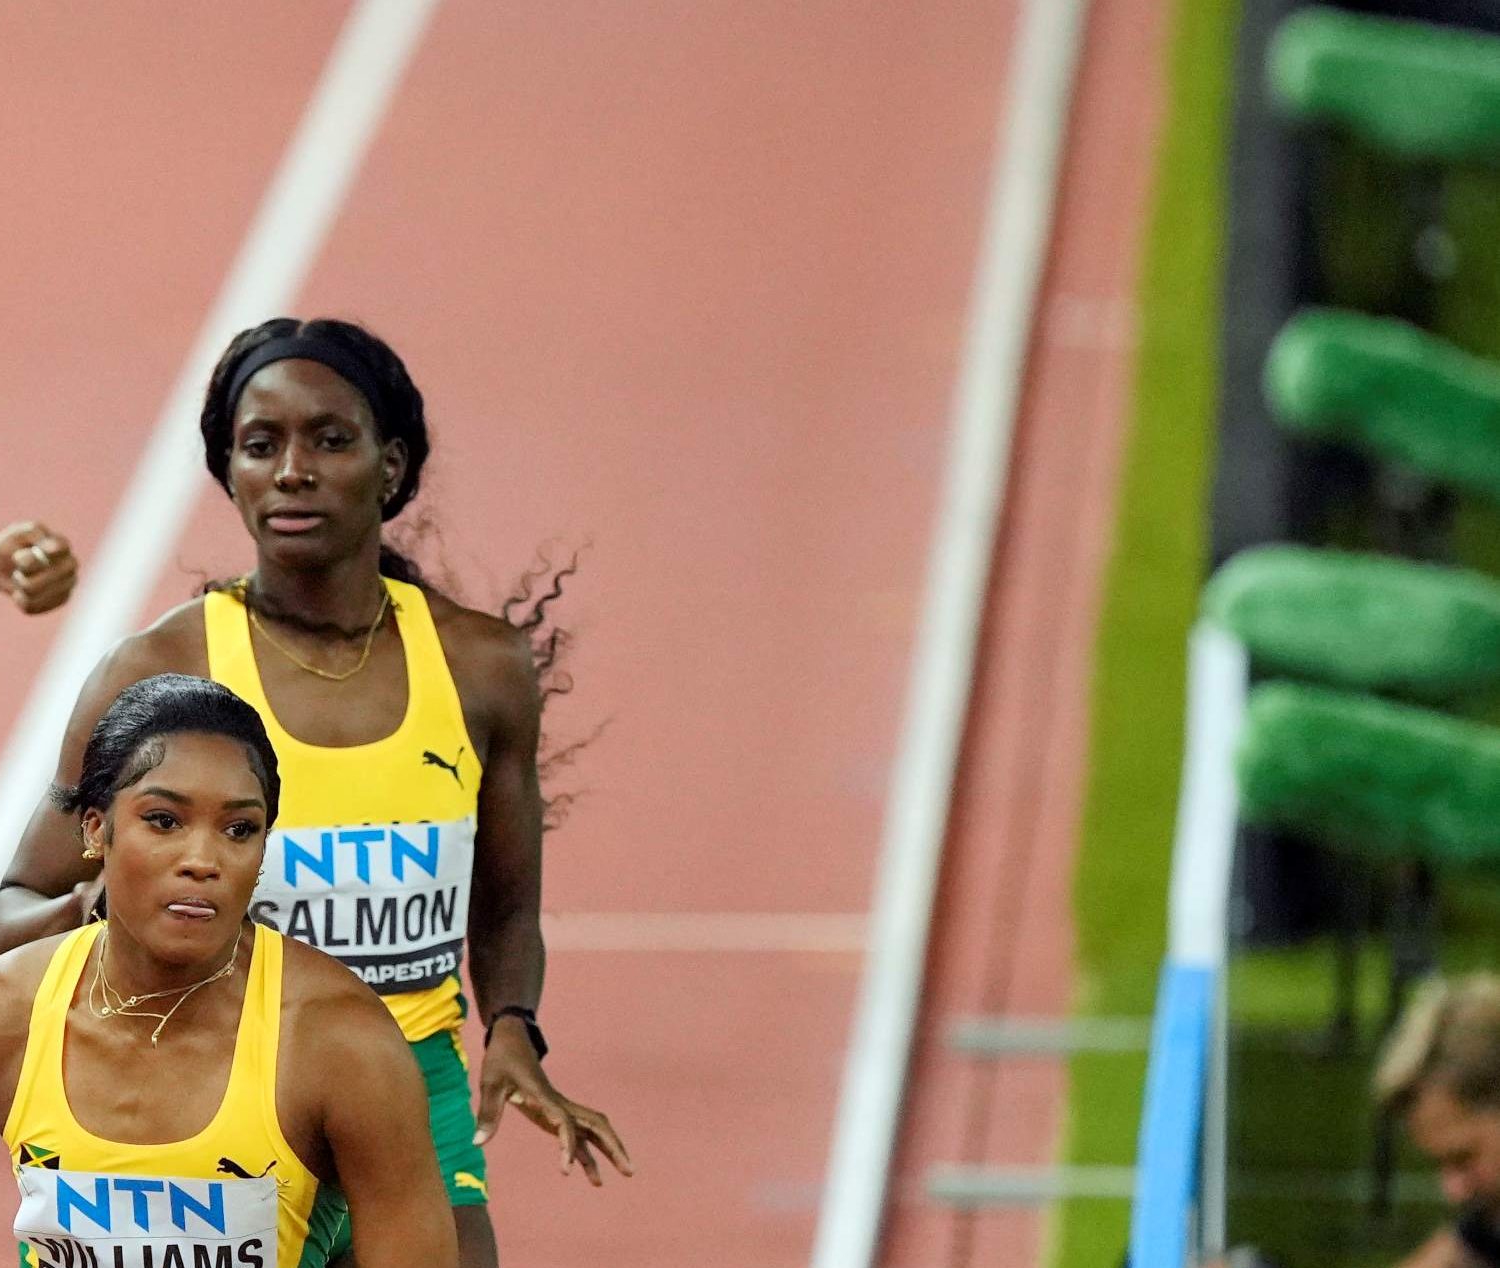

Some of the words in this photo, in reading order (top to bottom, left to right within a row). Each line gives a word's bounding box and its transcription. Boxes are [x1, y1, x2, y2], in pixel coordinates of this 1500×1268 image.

[283, 826, 440, 888] NTN
[250, 886, 457, 947] SALMON
[348, 957, 434, 984] APEST
[435, 951, 457, 974] 23
[56, 1174, 226, 1235] NTN
